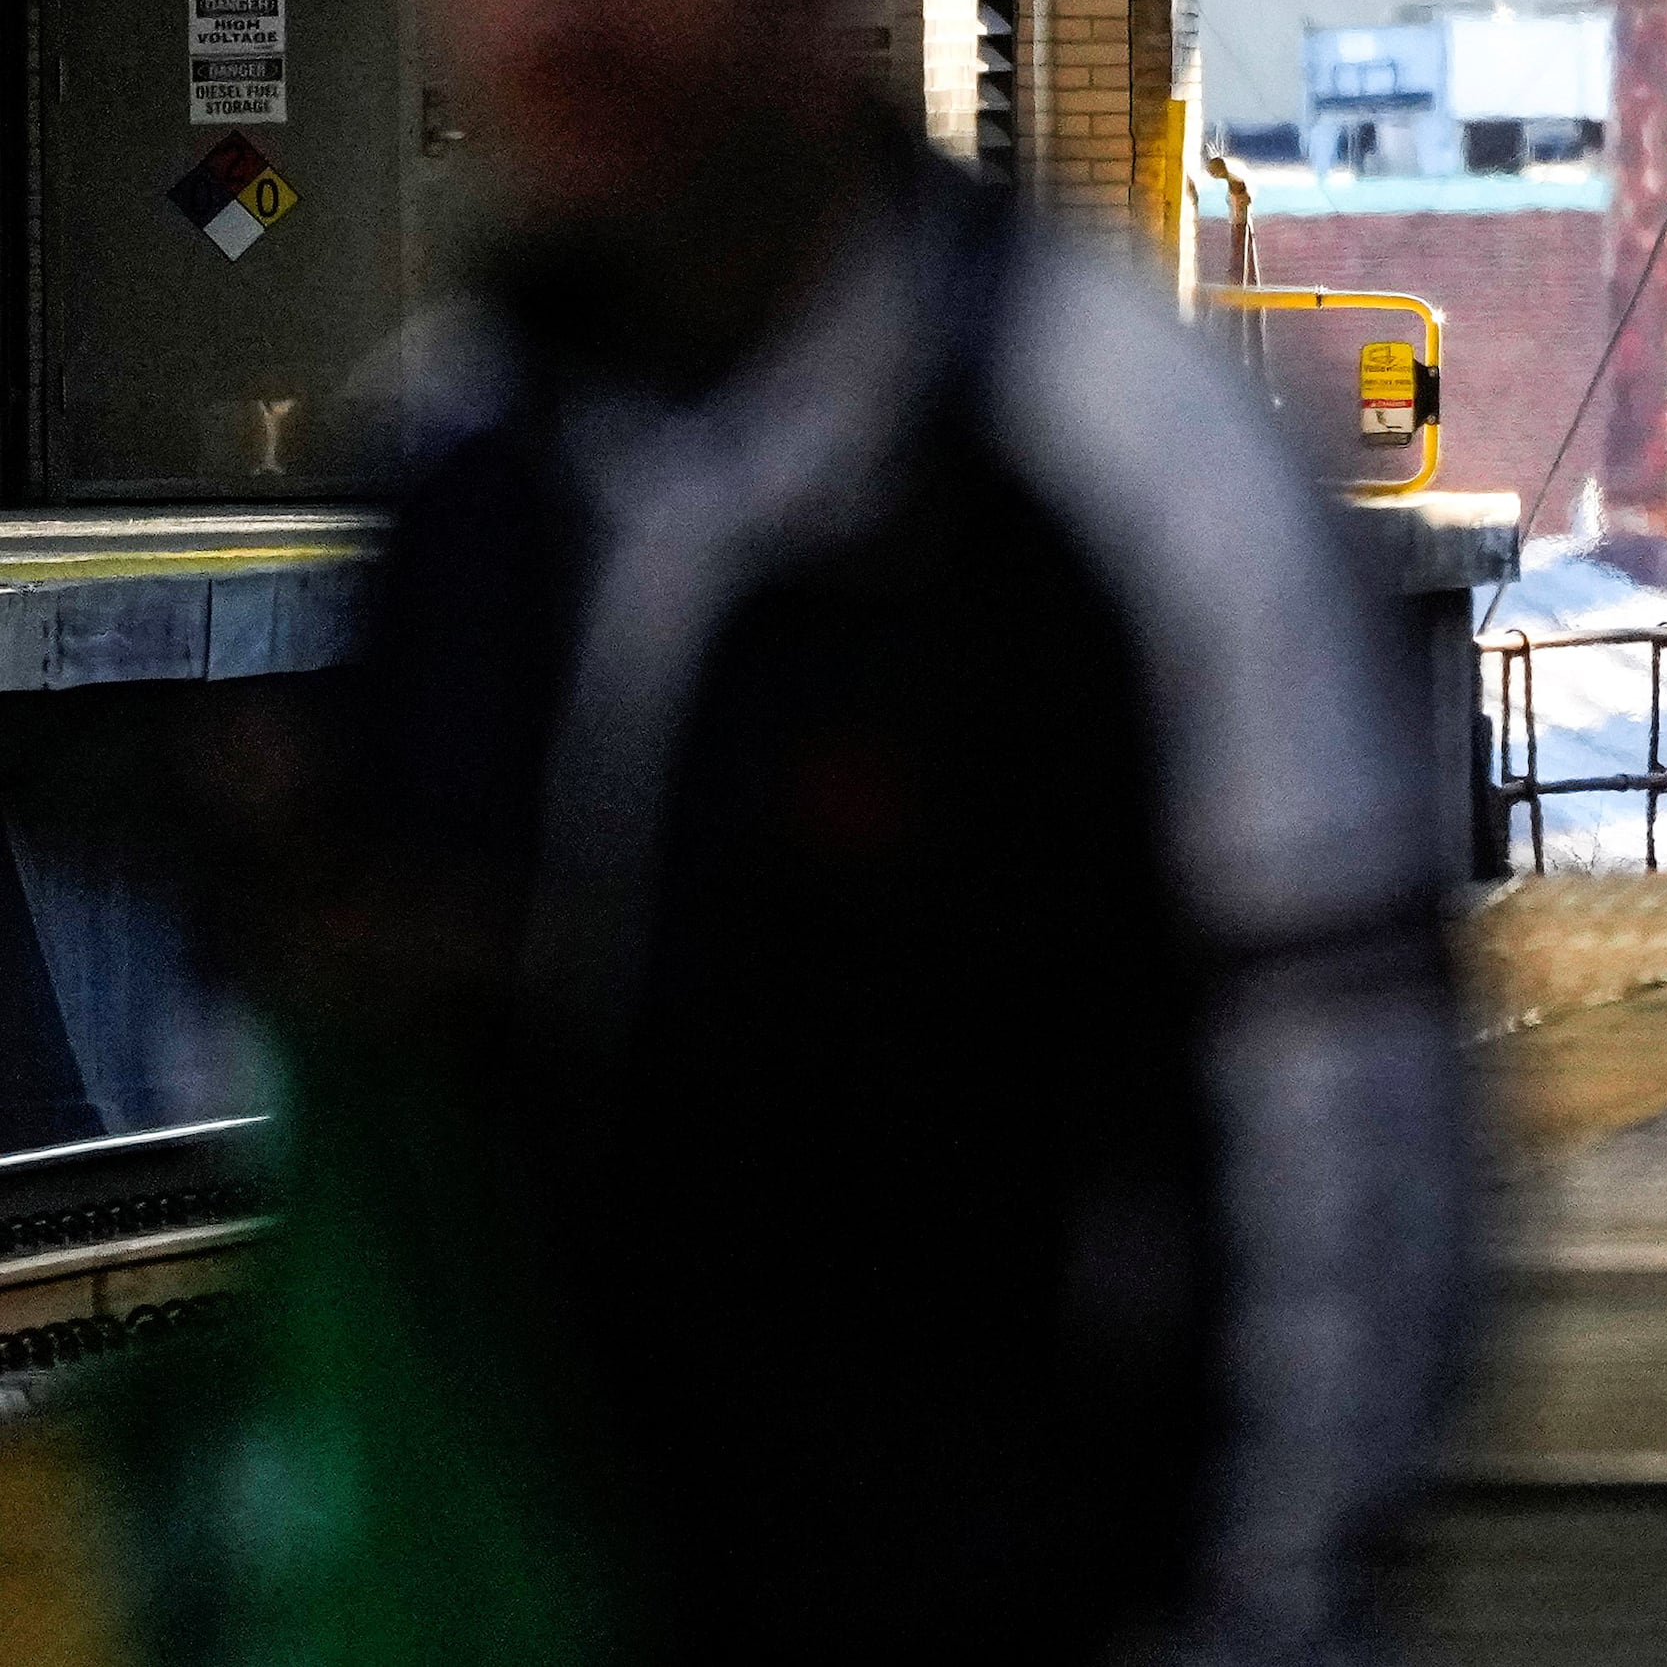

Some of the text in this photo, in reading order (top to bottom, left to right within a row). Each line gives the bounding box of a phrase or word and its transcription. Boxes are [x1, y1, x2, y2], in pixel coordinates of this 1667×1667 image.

[214, 19, 260, 31] HIGH
[197, 31, 279, 44] VOLTAGE
[195, 84, 241, 100] DIESEL
[205, 100, 271, 115] STORAGE
[256, 178, 279, 218] 0
